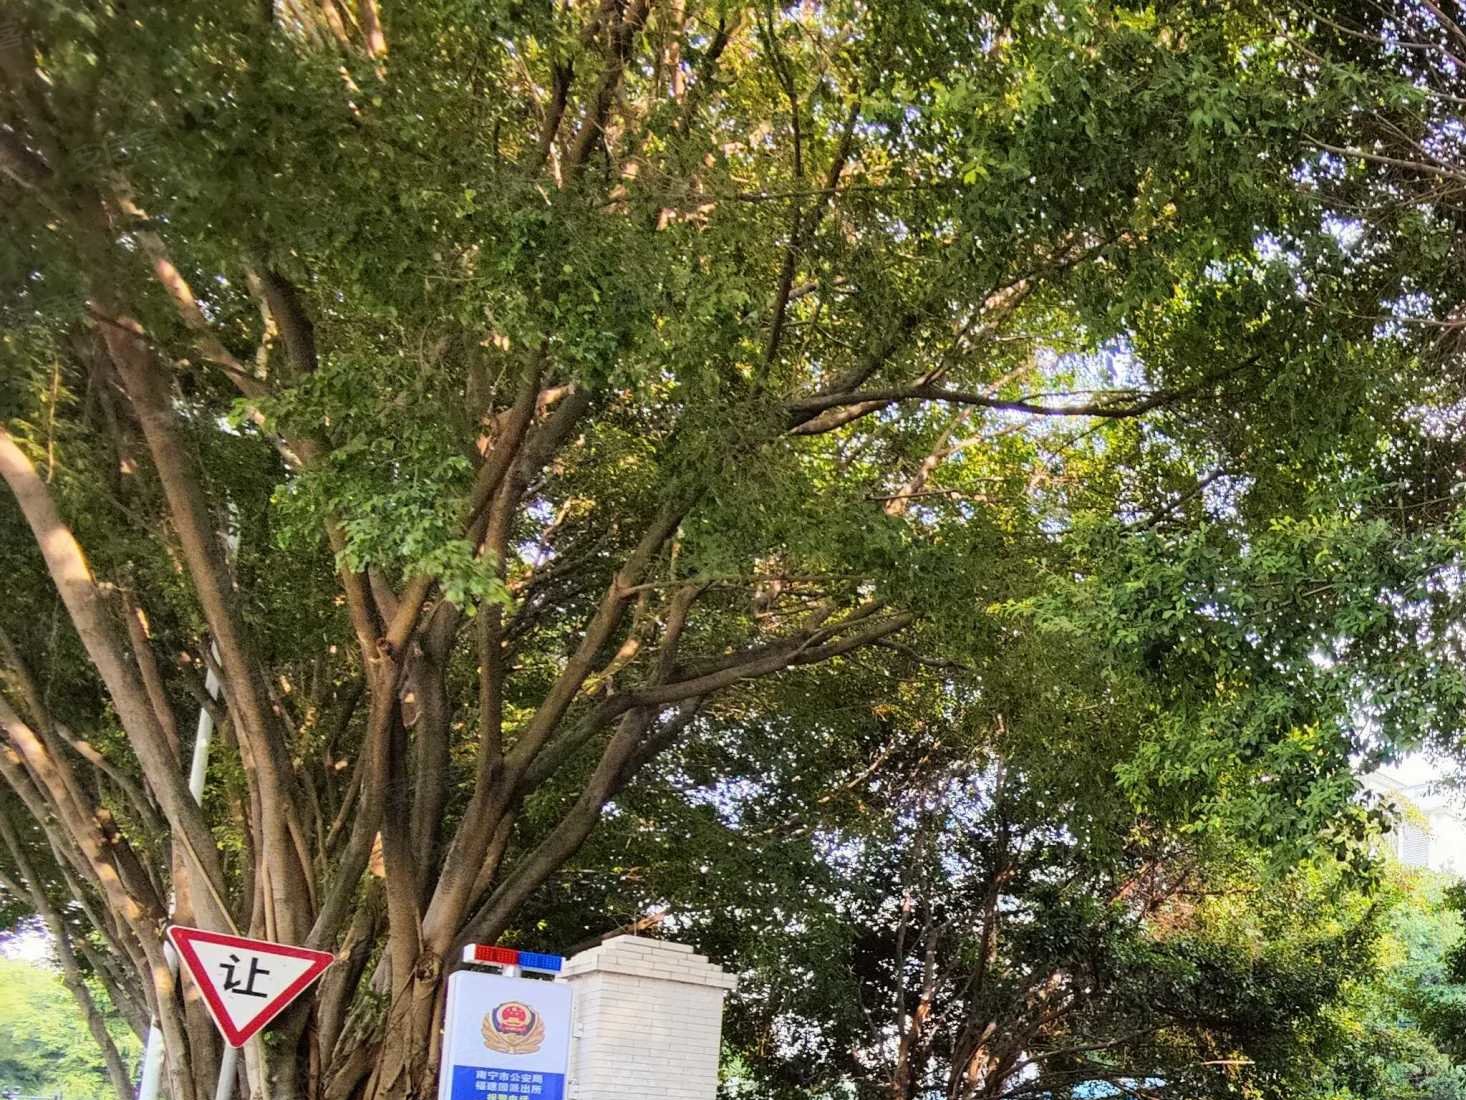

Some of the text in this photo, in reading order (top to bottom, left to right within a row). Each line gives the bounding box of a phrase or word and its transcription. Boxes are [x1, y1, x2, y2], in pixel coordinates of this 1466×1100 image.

[219, 954, 271, 998] 让
[475, 1070, 543, 1083] 南宁市公安局
